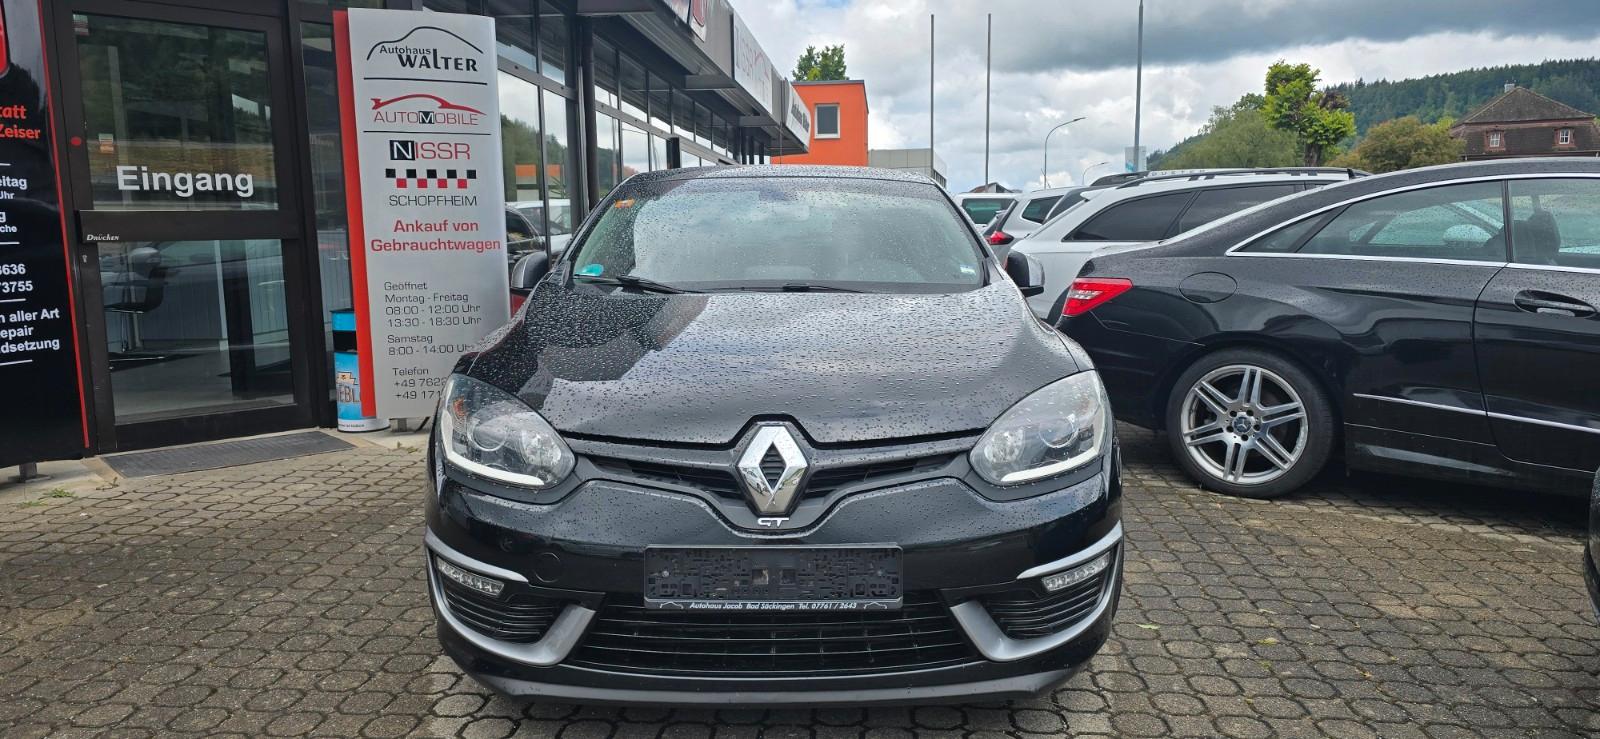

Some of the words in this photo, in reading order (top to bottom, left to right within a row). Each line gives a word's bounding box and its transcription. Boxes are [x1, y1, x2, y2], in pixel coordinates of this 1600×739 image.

[379, 45, 431, 56] Autohaus
[398, 49, 478, 72] WALTER
[374, 111, 479, 126] AUTOMOBILE
[392, 141, 471, 160] NISSR
[116, 165, 254, 198] Eingang
[388, 194, 477, 207] SCHOPFHEIM
[393, 219, 449, 233] Ankauf
[453, 221, 479, 232] von
[370, 238, 501, 254] Gebrauchtwagen
[0, 263, 26, 275] 636
[0, 280, 34, 293] 3755
[383, 281, 428, 291] Geöffnet
[385, 294, 425, 304] Montag
[433, 292, 469, 303] Freitag
[9, 310, 38, 322] aller
[40, 307, 60, 320] Art
[385, 305, 419, 315] 08:00
[428, 304, 459, 314] 12:00
[461, 304, 481, 313] Uhr
[387, 318, 420, 327] 13:30
[462, 316, 482, 325] Uhr
[387, 334, 433, 344] Samstag
[388, 346, 414, 356] 8:00
[423, 344, 454, 354] 14:00
[392, 367, 429, 376] Telefon
[394, 378, 416, 388] +49
[395, 390, 417, 400] +49
[757, 517, 790, 527] GT
[689, 602, 722, 610] Autohaus
[723, 602, 743, 610] Jacob
[746, 602, 760, 610] Bad
[760, 602, 795, 611] Säckingen
[811, 602, 832, 610] 07761
